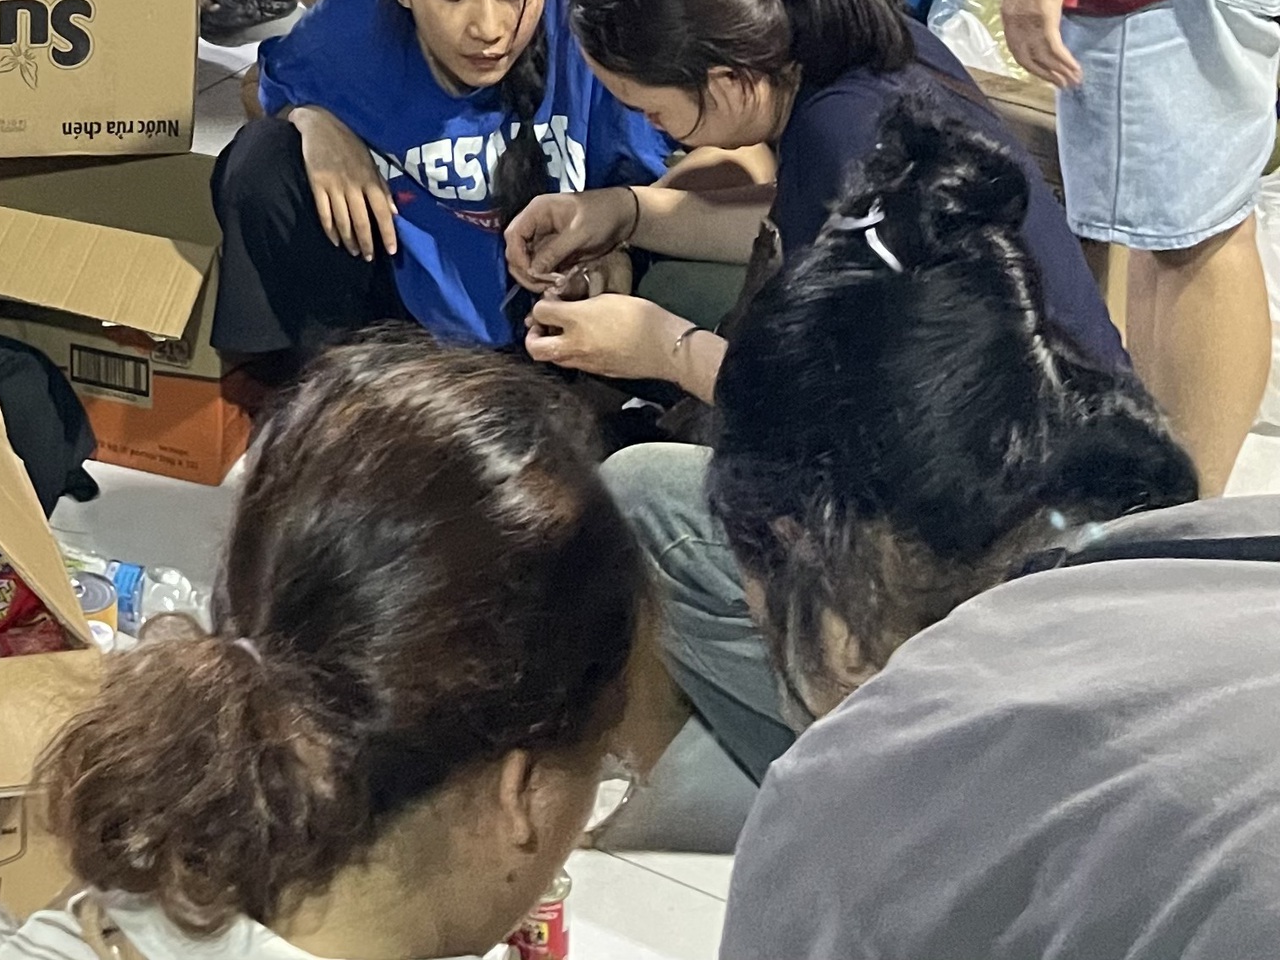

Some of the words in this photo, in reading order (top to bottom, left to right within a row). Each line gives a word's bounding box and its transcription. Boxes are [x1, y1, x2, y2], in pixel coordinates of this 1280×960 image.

[62, 120, 102, 141] chén
[105, 120, 134, 141] rửa
[138, 119, 179, 139] Nước
